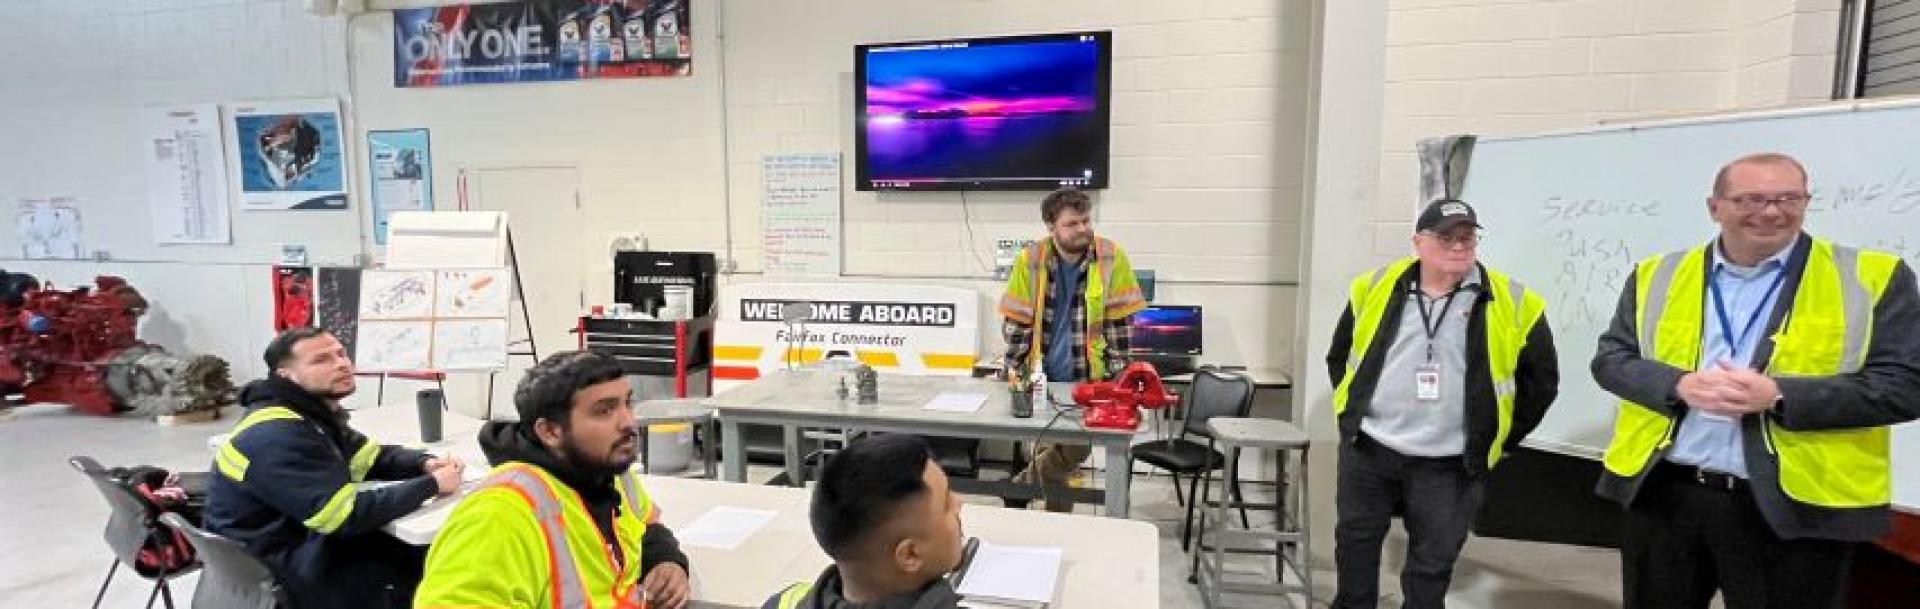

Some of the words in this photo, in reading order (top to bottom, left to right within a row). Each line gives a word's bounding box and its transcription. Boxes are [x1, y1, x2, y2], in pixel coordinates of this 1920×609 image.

[404, 28, 477, 61] ONLY
[482, 24, 550, 59] ONE.
[860, 305, 953, 324] ABOARD
[776, 329, 826, 343] Fairfax
[832, 332, 907, 347] Connector
